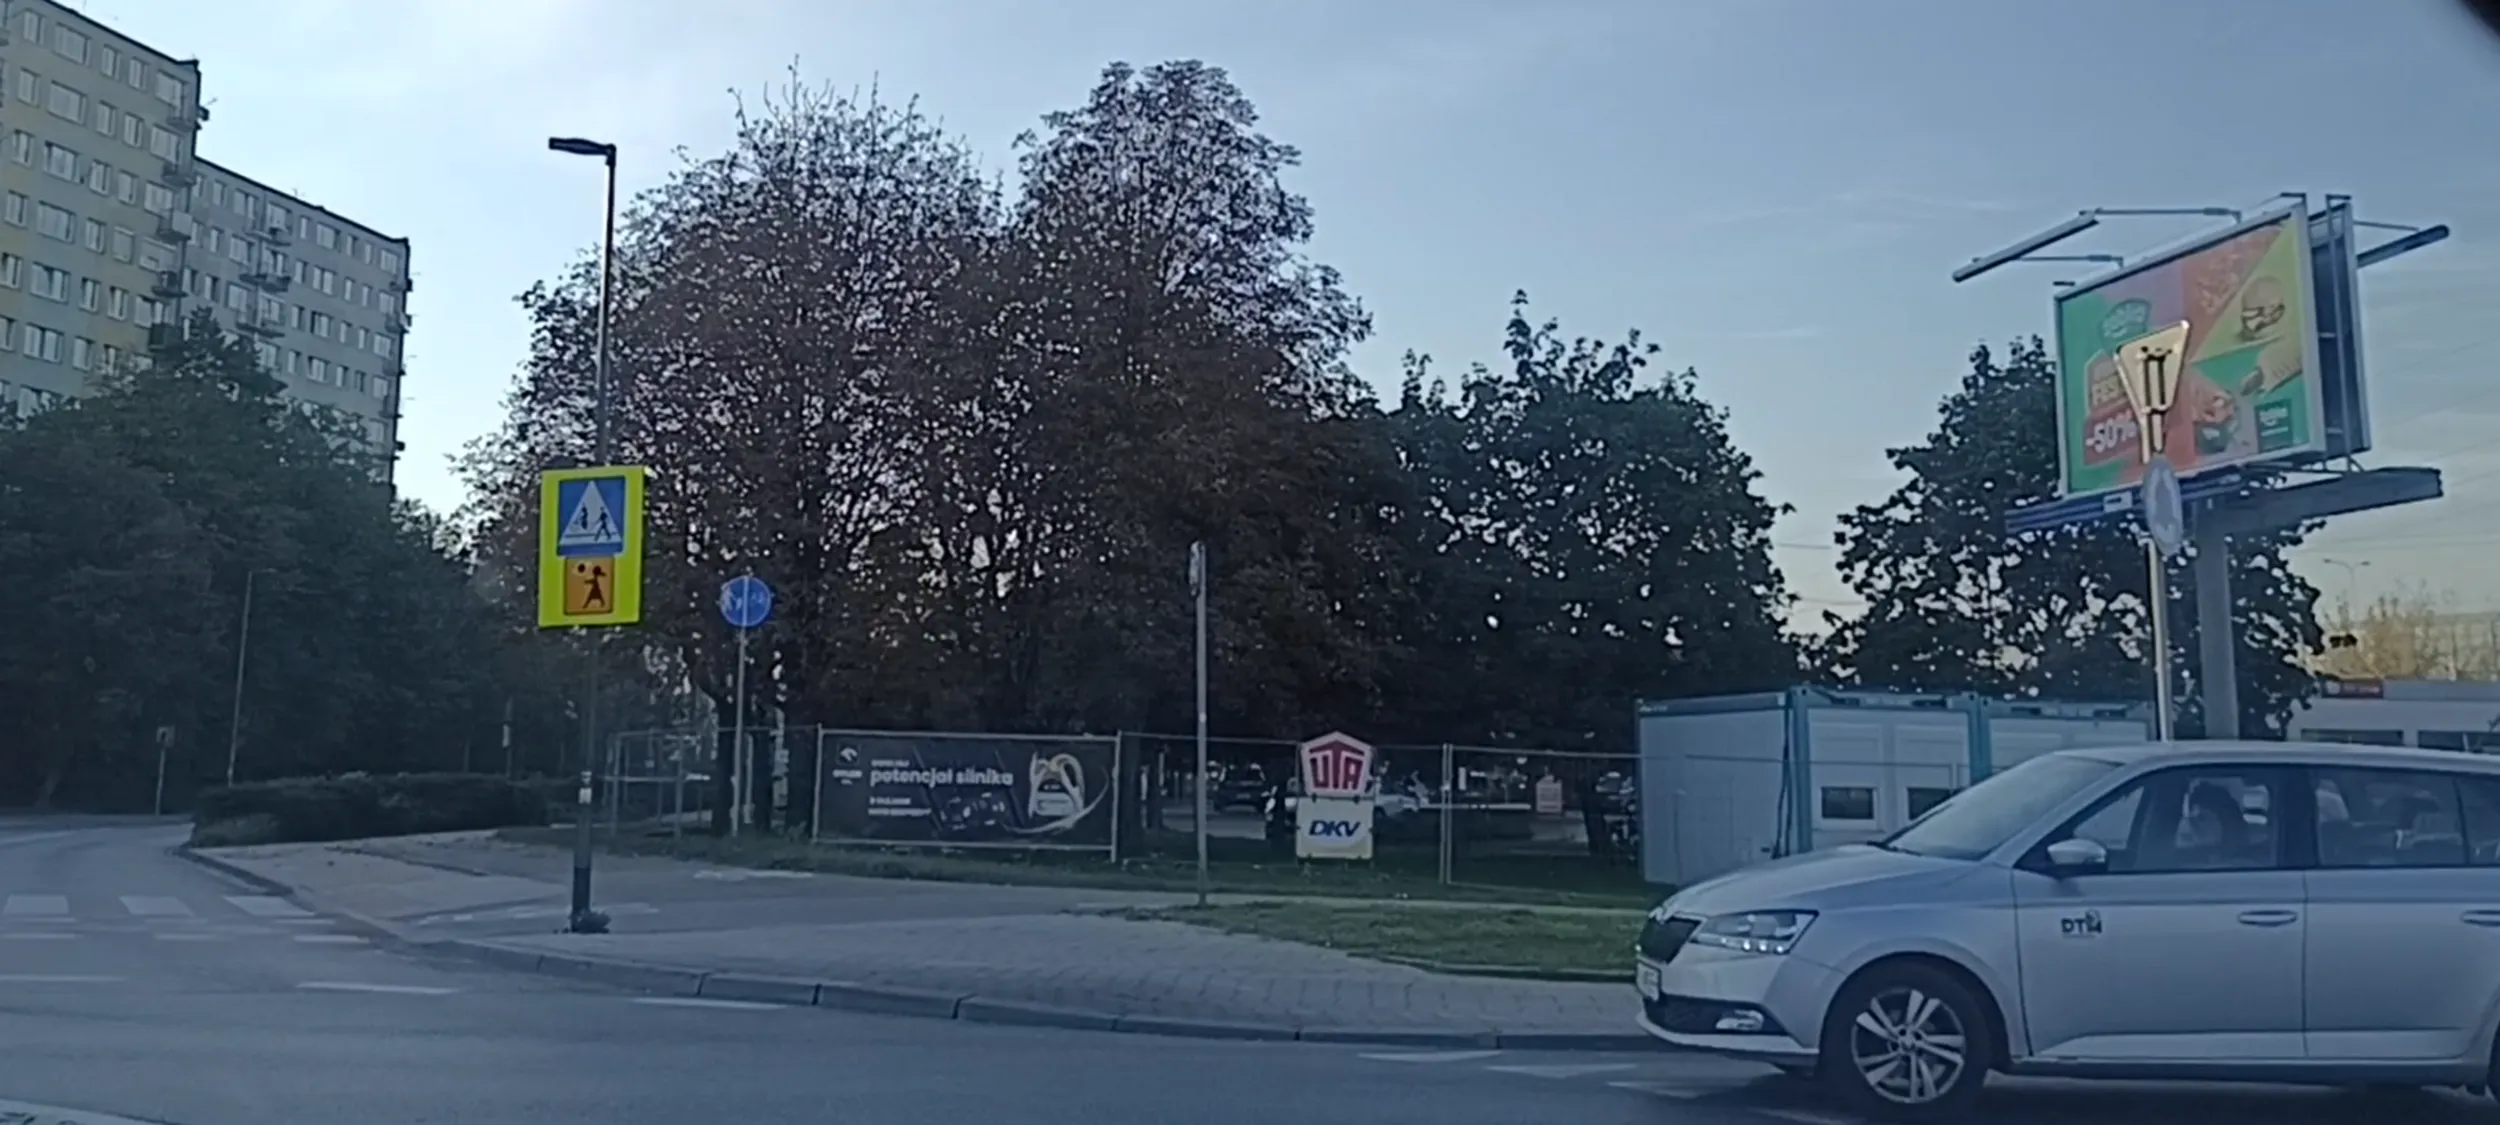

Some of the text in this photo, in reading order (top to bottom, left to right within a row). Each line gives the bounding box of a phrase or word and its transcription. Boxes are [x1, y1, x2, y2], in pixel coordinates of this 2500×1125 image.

[1309, 740, 1365, 789] UTA
[956, 766, 1014, 786] silnika
[1309, 820, 1361, 837] DKV
